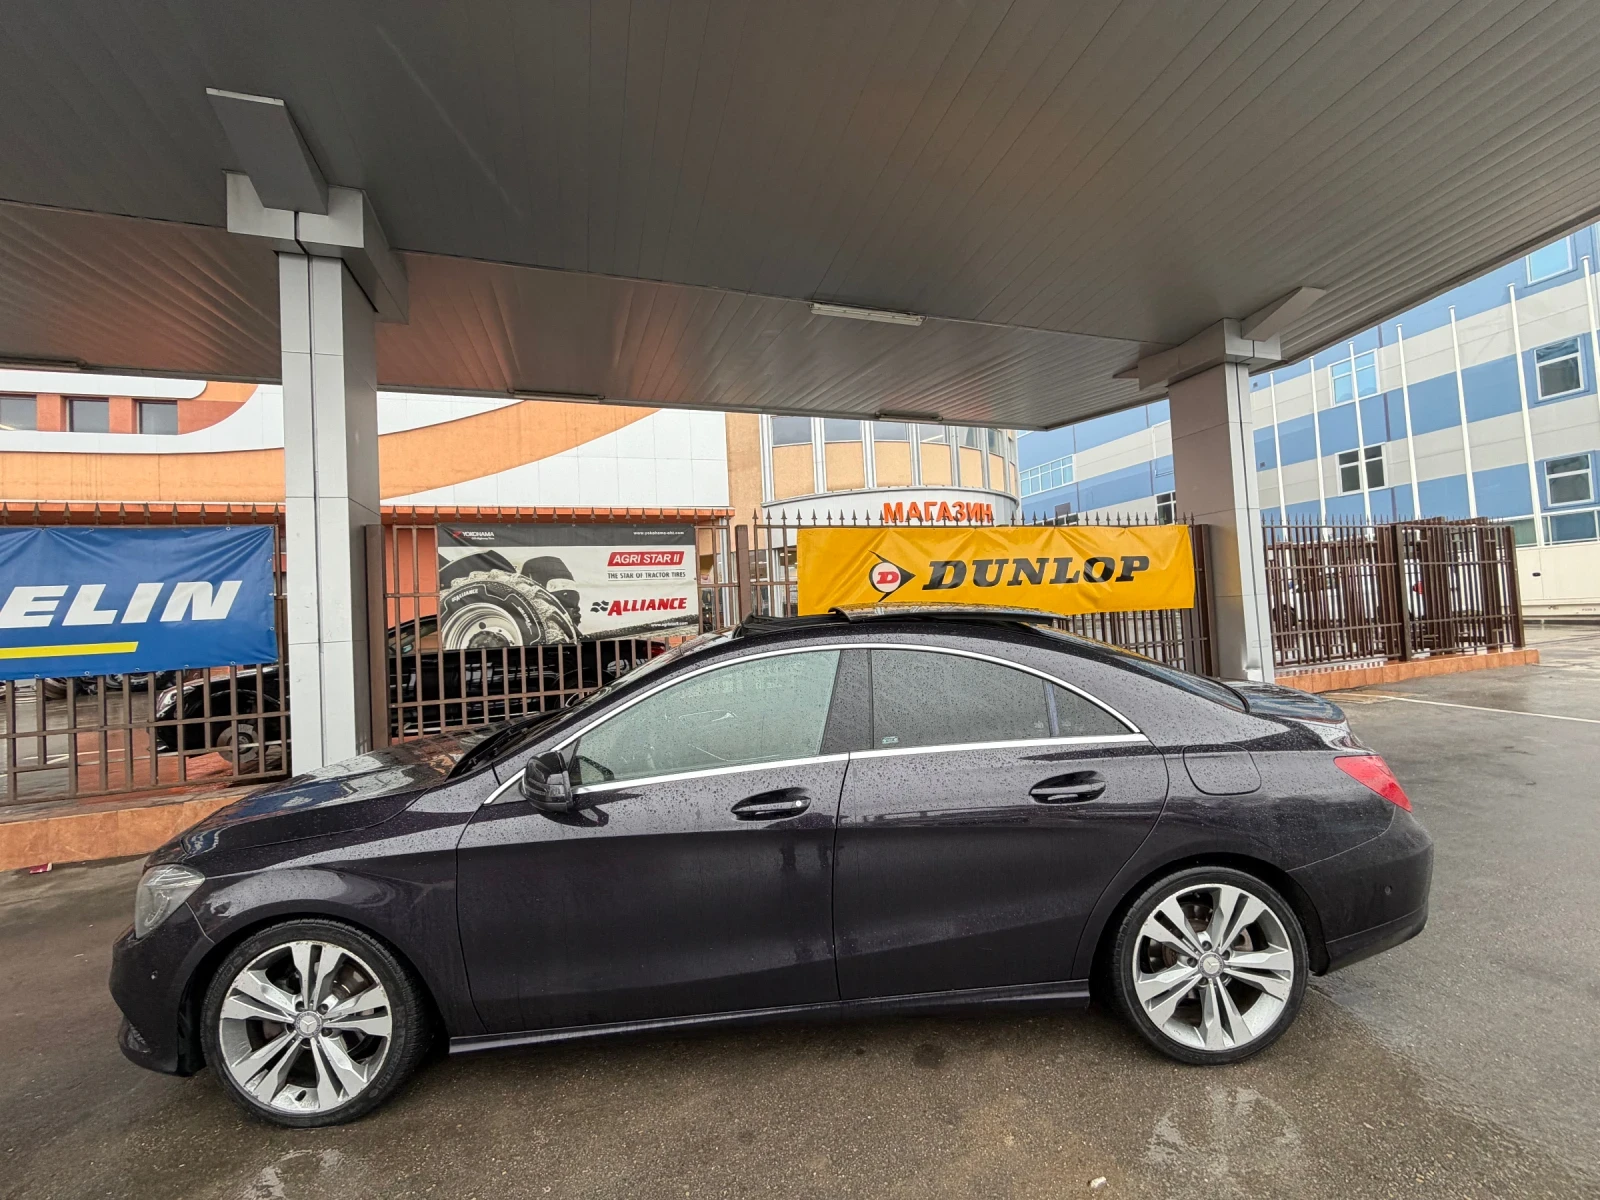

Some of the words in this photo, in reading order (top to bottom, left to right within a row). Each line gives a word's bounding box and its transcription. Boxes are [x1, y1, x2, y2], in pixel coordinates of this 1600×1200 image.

[883, 501, 992, 524] МАГАЗИН
[612, 554, 641, 564] AGRI
[643, 554, 671, 563] STAR
[876, 571, 900, 585] D
[922, 556, 1150, 590] DUNLOP
[0, 580, 243, 628] ELIN
[607, 597, 688, 616] ALLIANCE
